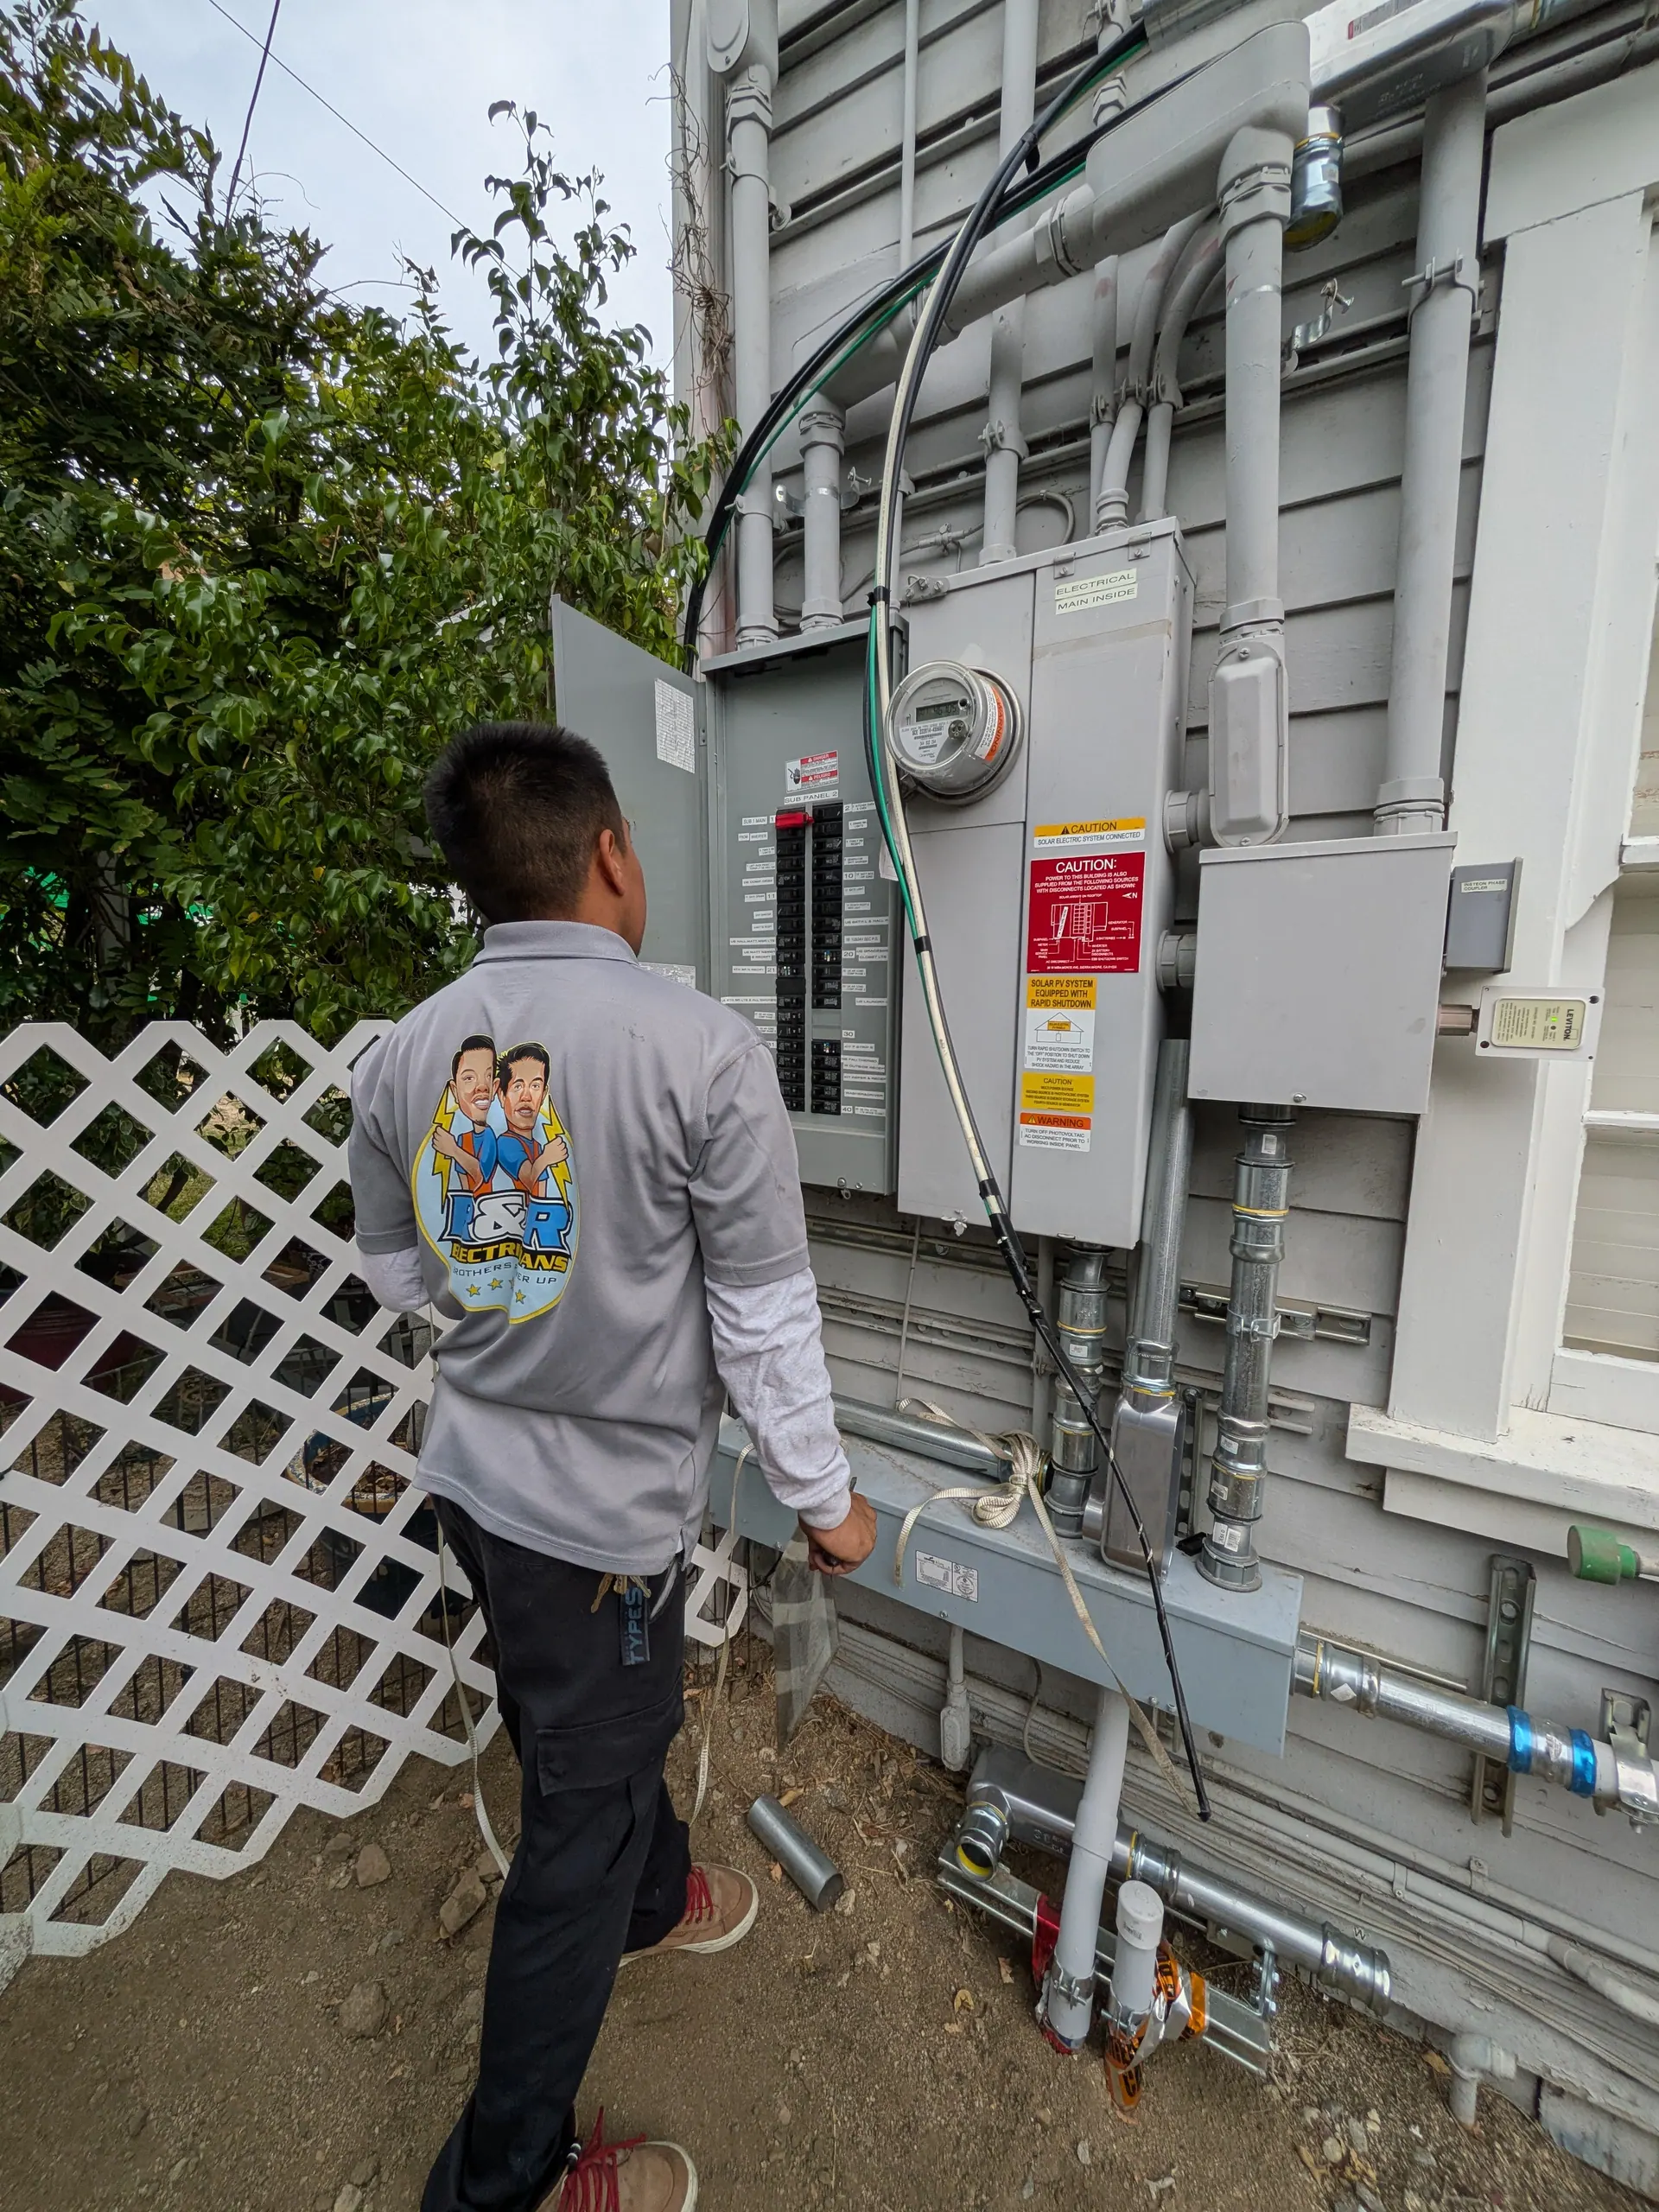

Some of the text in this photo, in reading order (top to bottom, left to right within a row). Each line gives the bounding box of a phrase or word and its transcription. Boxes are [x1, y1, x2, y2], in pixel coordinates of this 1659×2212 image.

[1056, 573, 1135, 595] ELECTRICAL
[1058, 588, 1135, 610] MAIN INSIDE
[990, 702, 1003, 753] WARNING
[804, 792, 829, 801] PANEL
[1071, 822, 1117, 834] CAUTION
[1106, 832, 1141, 841] CONNECTED
[1056, 859, 1117, 874] CAUTION:
[1035, 989, 1070, 998] EQUIPPED
[1052, 1000, 1091, 1008] SHUTDOWN
[1563, 1008, 1574, 1039] LEVITON
[1037, 1116, 1084, 1128] WARNING
